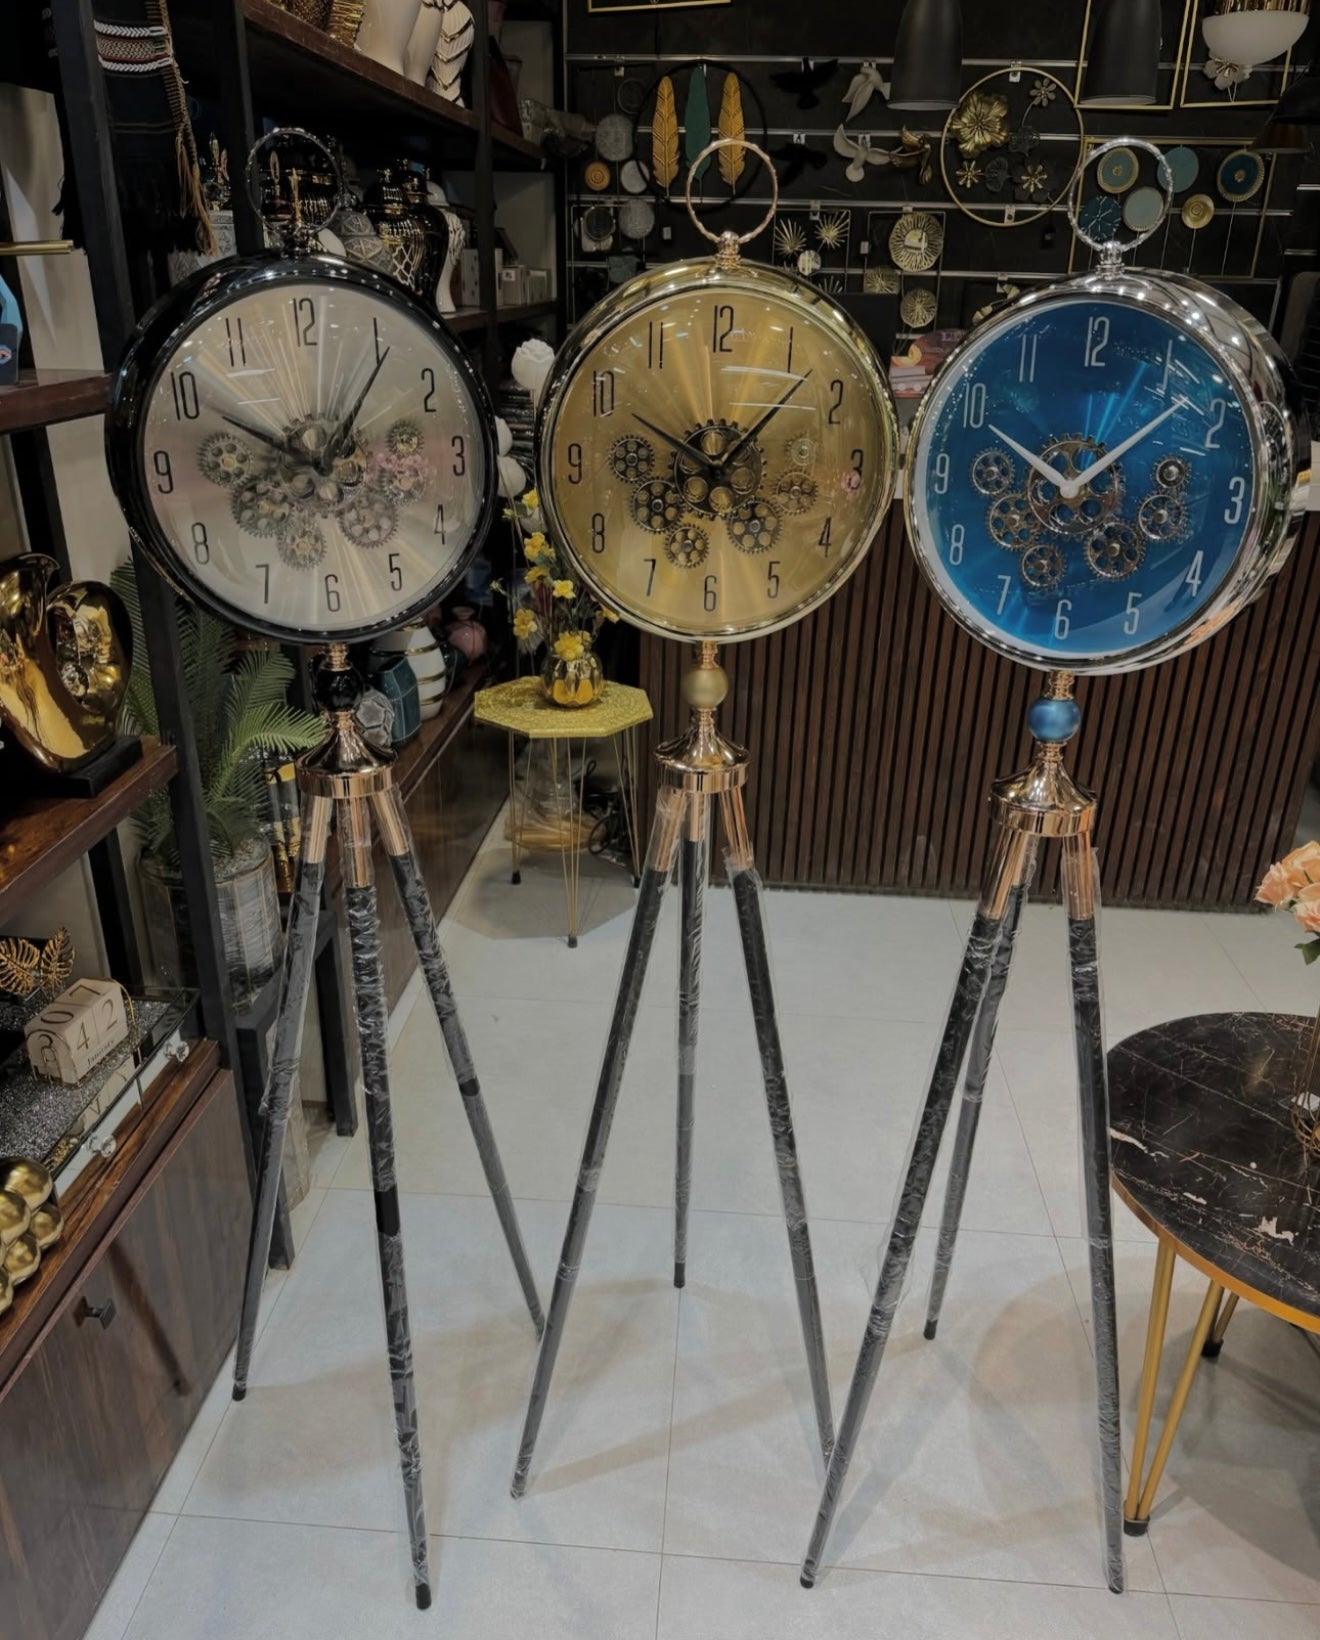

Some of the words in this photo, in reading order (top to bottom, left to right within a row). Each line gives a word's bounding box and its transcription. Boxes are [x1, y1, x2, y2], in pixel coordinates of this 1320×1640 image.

[225, 317, 246, 367] 11
[293, 297, 318, 347] 12
[373, 317, 381, 365] 1
[712, 305, 734, 353] 12
[1084, 316, 1109, 367] 12
[648, 321, 664, 369] 11
[787, 327, 793, 373] 1
[1019, 334, 1037, 383] 11
[1162, 339, 1172, 390] 1
[170, 371, 200, 421] 10
[421, 368, 437, 413] 2
[593, 370, 615, 417] 10
[828, 379, 843, 425] 2
[963, 382, 987, 429] 10
[1205, 398, 1226, 449] 2
[153, 450, 174, 494] 9
[451, 435, 466, 476] 3
[568, 443, 583, 485] 9
[850, 449, 864, 490] 3
[934, 453, 950, 494] 9
[1224, 476, 1245, 524] 3
[191, 522, 210, 565] 8
[433, 504, 446, 545] 4
[592, 513, 606, 554] 8
[818, 517, 832, 558] 4
[949, 524, 965, 566] 8
[255, 564, 269, 604] 7
[324, 574, 341, 612] 6
[388, 553, 402, 592] 5
[643, 558, 657, 597] 7
[703, 575, 717, 612] 6
[767, 561, 780, 599] 5
[1185, 550, 1203, 597] 4
[997, 575, 1011, 615] 7
[1123, 592, 1142, 635] 5
[1054, 599, 1072, 640] 6
